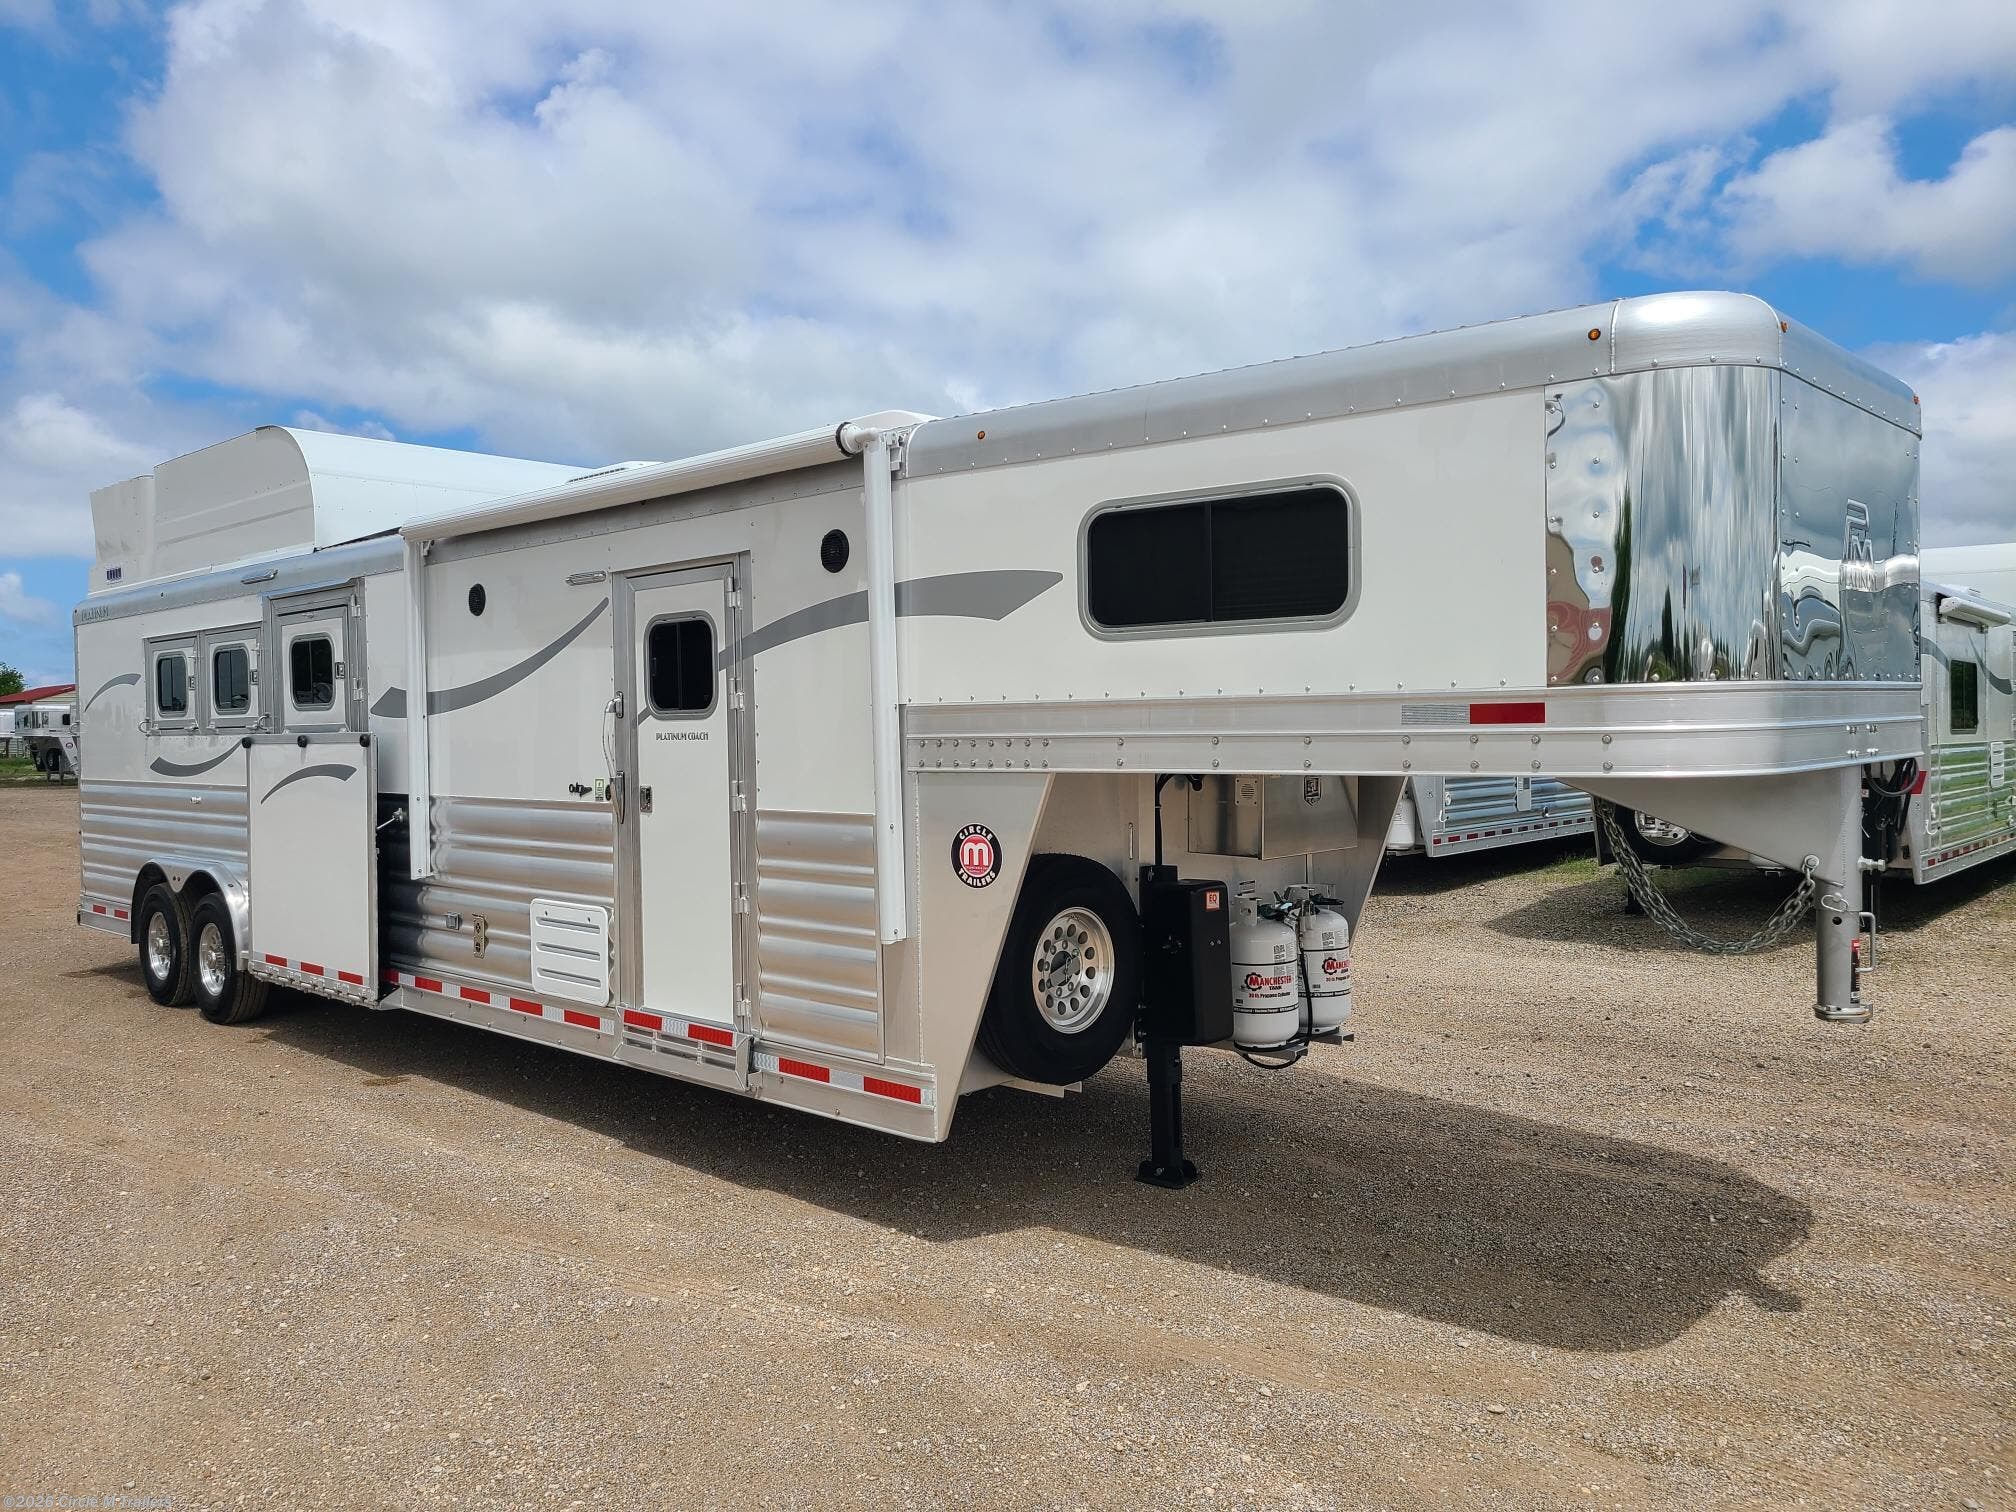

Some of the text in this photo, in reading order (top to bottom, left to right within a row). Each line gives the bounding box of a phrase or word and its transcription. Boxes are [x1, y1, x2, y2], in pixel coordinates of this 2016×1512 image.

[655, 732, 709, 741] PLATINUM COACH
[959, 825, 993, 841] CIRCLE
[958, 868, 996, 887] TRAILERS
[1248, 974, 1292, 987] MANCHESTER
